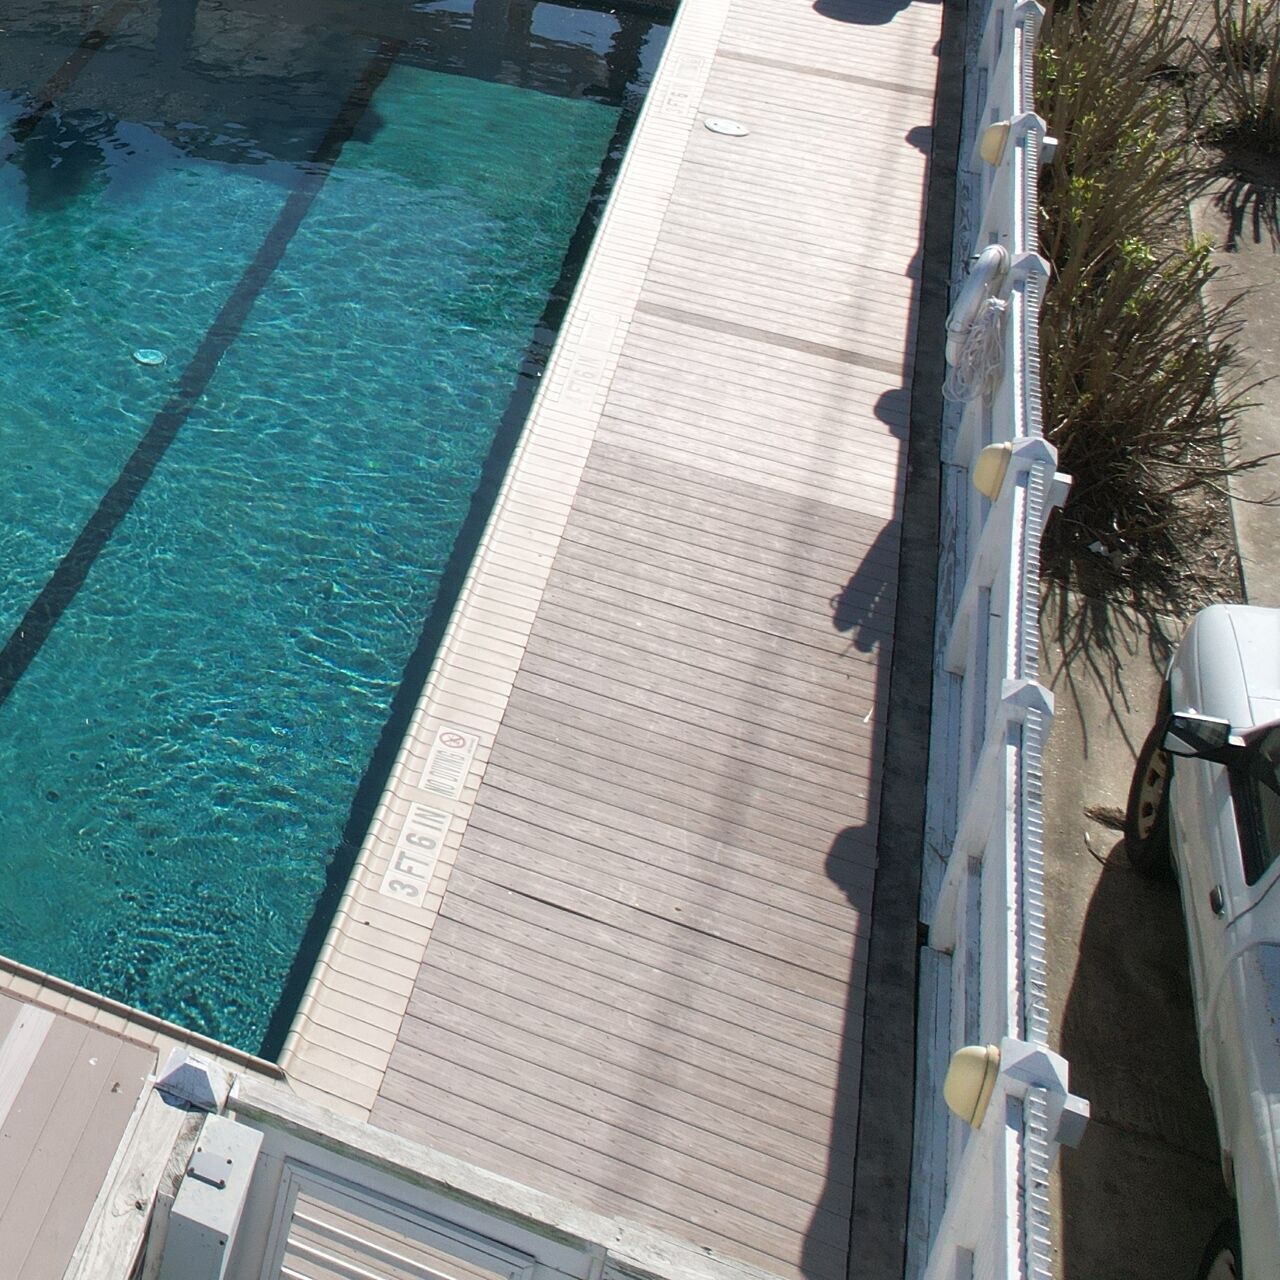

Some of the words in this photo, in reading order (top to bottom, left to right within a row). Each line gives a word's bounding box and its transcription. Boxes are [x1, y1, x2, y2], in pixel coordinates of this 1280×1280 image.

[412, 806, 446, 832] IN
[406, 832, 436, 850] 6
[394, 851, 430, 878] FT
[388, 880, 418, 898] 3
